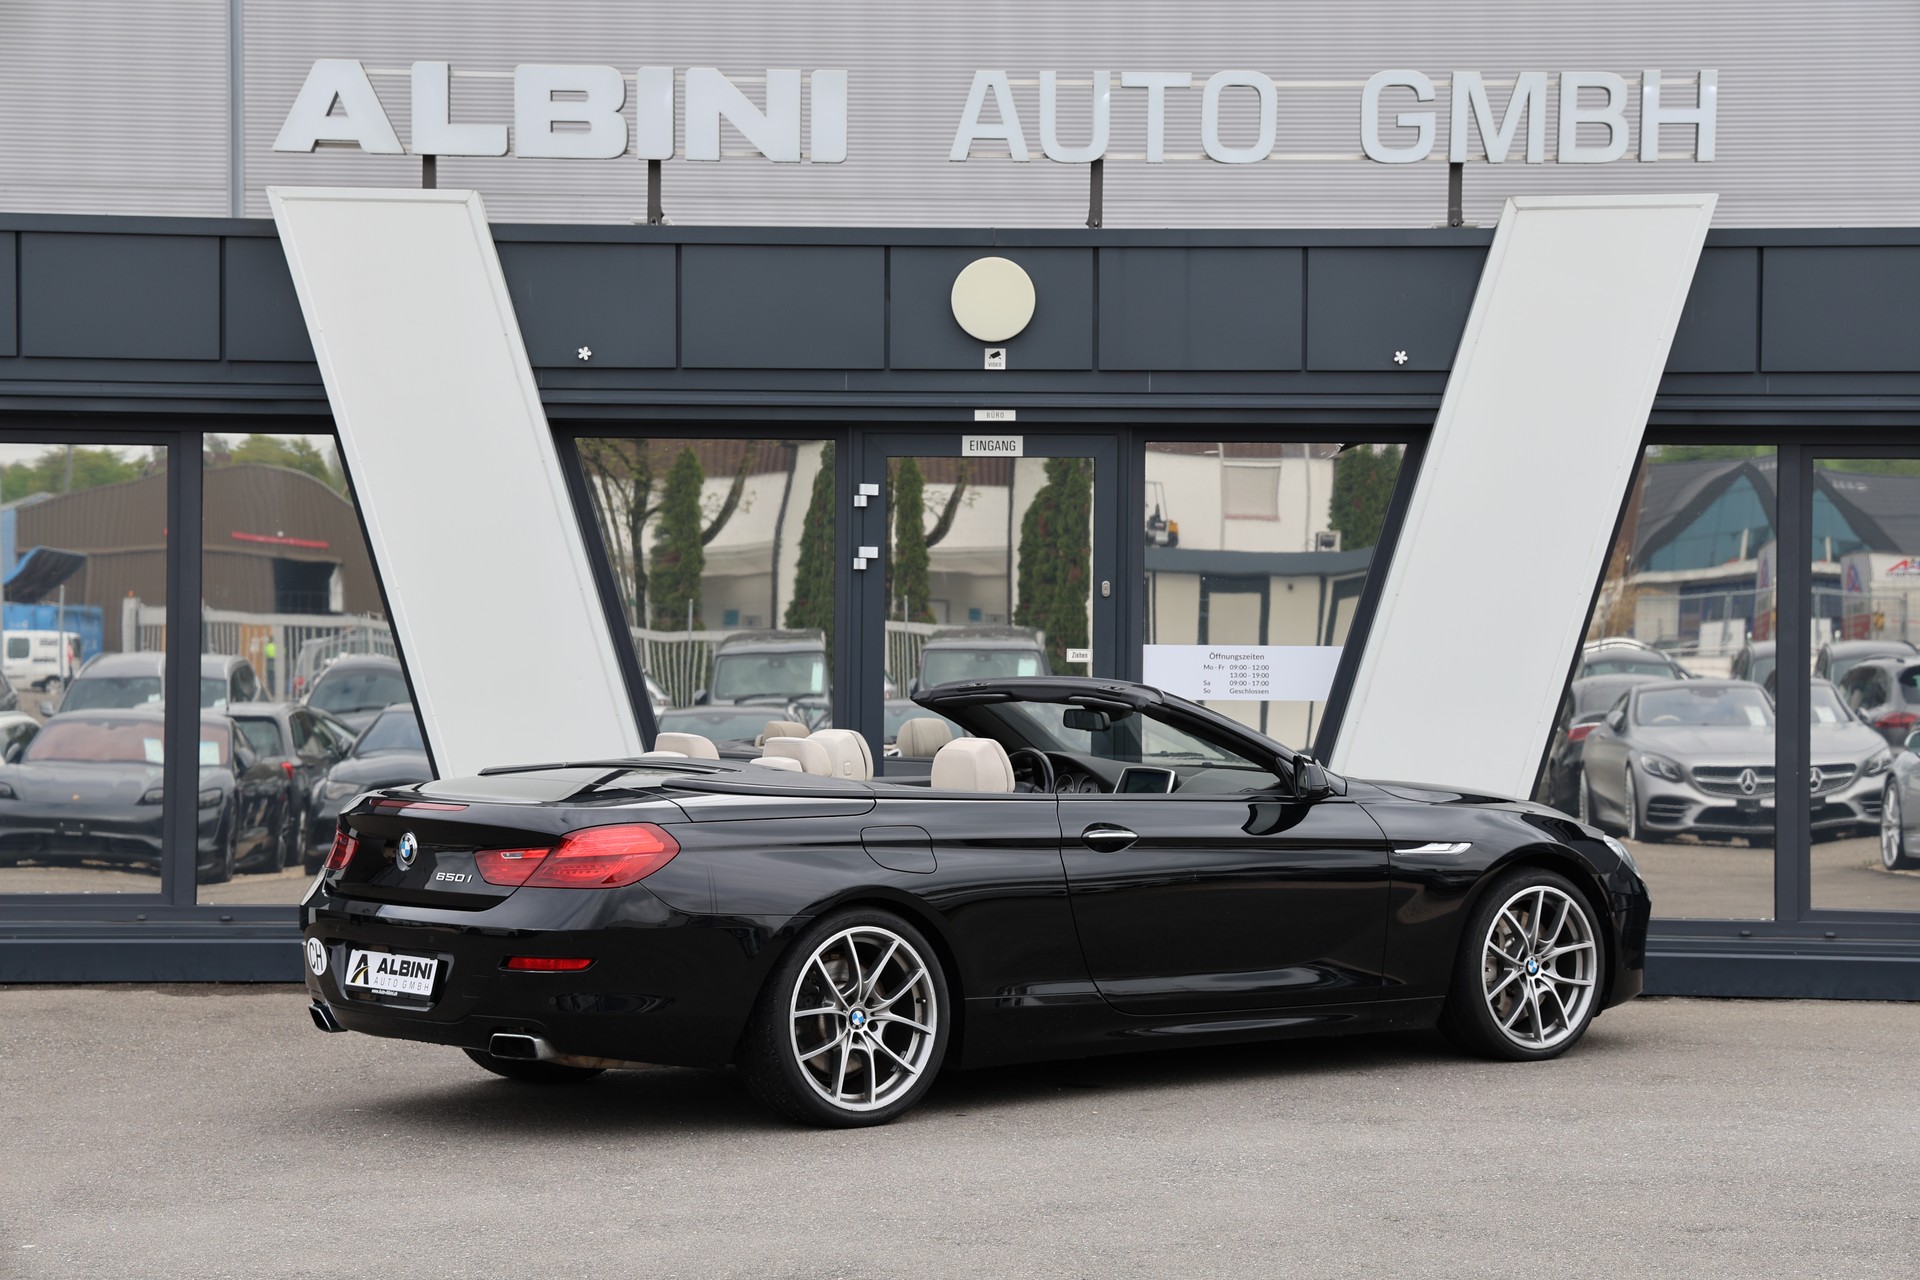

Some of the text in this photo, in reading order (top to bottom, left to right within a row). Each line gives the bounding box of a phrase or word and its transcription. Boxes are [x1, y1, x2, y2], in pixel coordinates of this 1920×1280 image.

[271, 58, 1719, 164] ALBINI AUTO GMBH
[986, 411, 1005, 419] BÜRO
[969, 440, 1016, 452] EINGANG
[1208, 652, 1265, 661] Öffnungszeiten
[1229, 687, 1270, 695] Geschlossen
[309, 941, 324, 972] CH
[376, 957, 434, 980] ALBINI
[373, 976, 430, 991] AUTO GMBH
